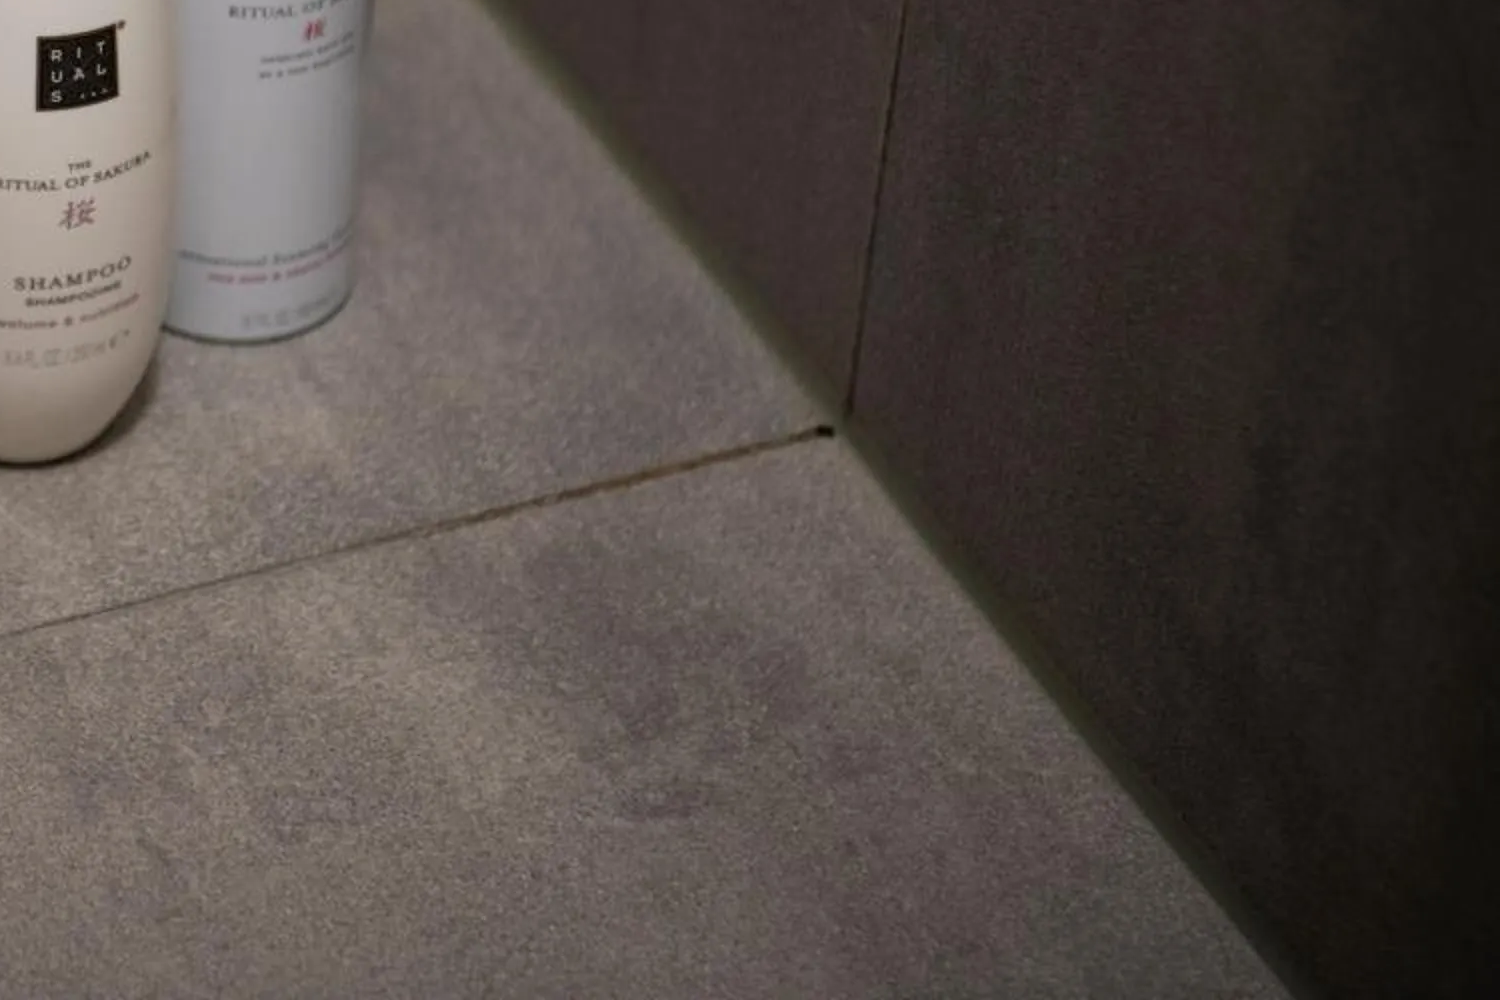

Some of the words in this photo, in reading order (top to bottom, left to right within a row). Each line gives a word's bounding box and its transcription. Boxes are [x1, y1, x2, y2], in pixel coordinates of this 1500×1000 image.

[227, 4, 298, 20] RITUAL
[64, 174, 91, 190] OF
[92, 150, 152, 183] SAKURA
[68, 159, 93, 173] THE
[12, 254, 133, 292] SHAMPOO
